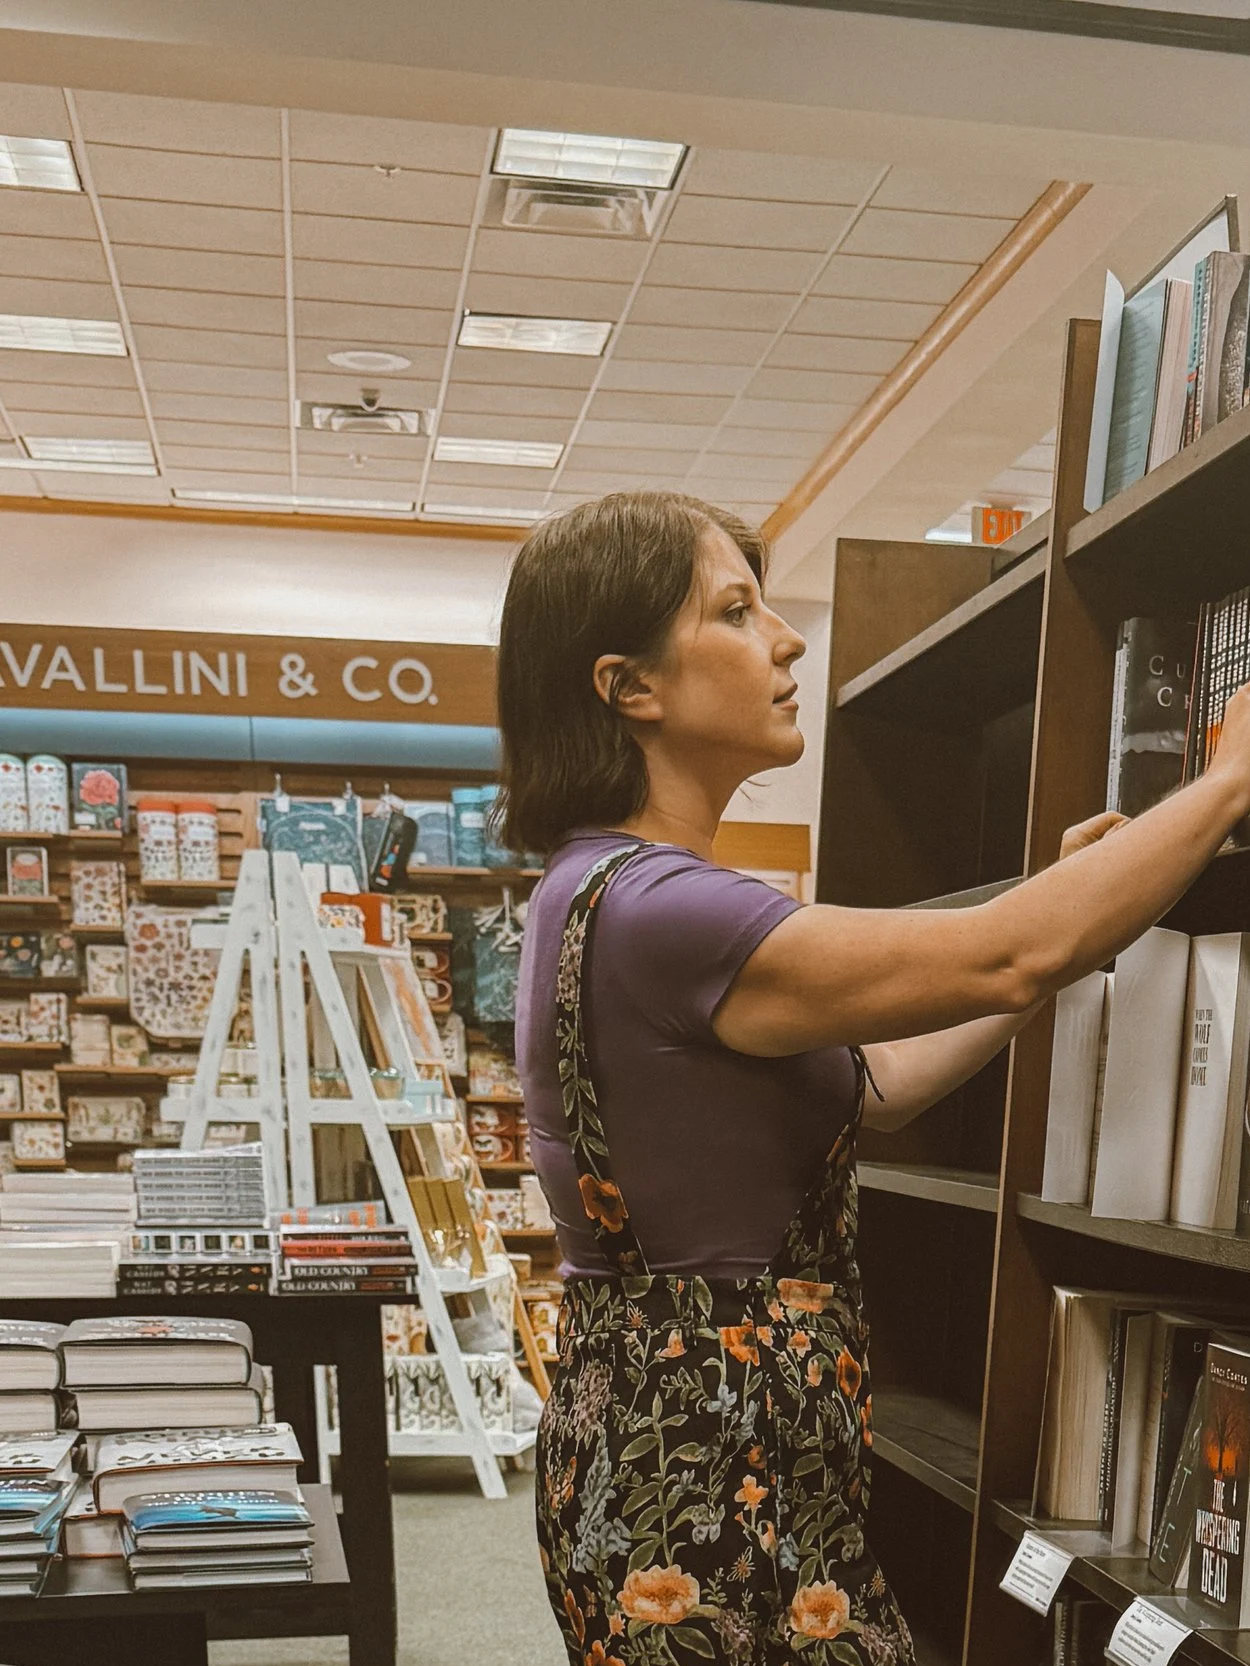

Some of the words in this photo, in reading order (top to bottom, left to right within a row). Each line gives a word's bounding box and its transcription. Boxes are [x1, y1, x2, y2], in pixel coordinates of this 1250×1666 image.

[0, 641, 248, 698] VALLINI
[279, 653, 319, 699] &
[341, 655, 440, 706] CO.
[281, 1280, 307, 1292] OLD
[310, 1279, 356, 1292] COUNTRY
[295, 1265, 321, 1277] OLD
[323, 1264, 368, 1277] COUNTRY
[1200, 1547, 1229, 1604] DEAD
